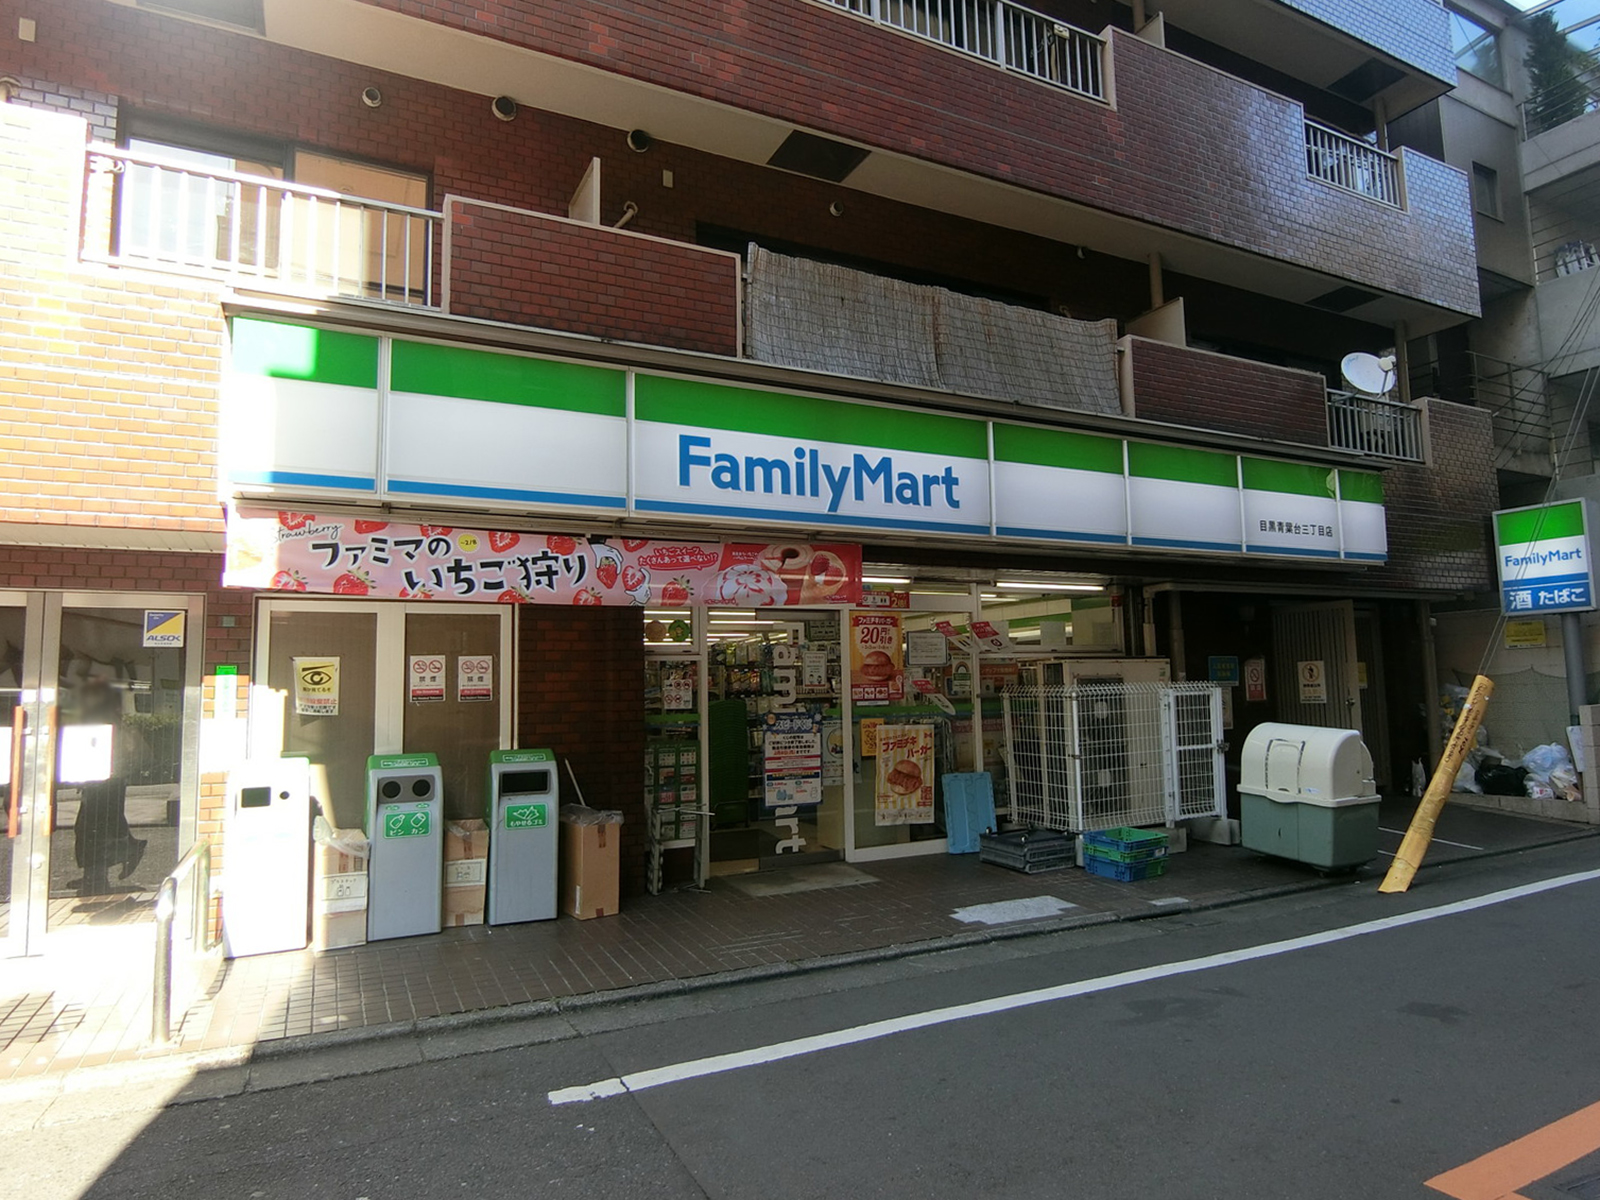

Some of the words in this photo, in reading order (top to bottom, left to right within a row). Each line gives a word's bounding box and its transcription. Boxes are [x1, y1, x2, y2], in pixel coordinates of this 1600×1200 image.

[679, 434, 960, 512] FamilyMart
[1260, 519, 1333, 537] 目黒青葉台三丁目店
[312, 537, 451, 567] ファミマの
[1505, 548, 1582, 567] FamilyMart
[404, 551, 586, 595] いちご狩り
[1510, 590, 1532, 609] 酒
[1538, 588, 1586, 605] たばこ
[882, 736, 917, 752] ファミチキ
